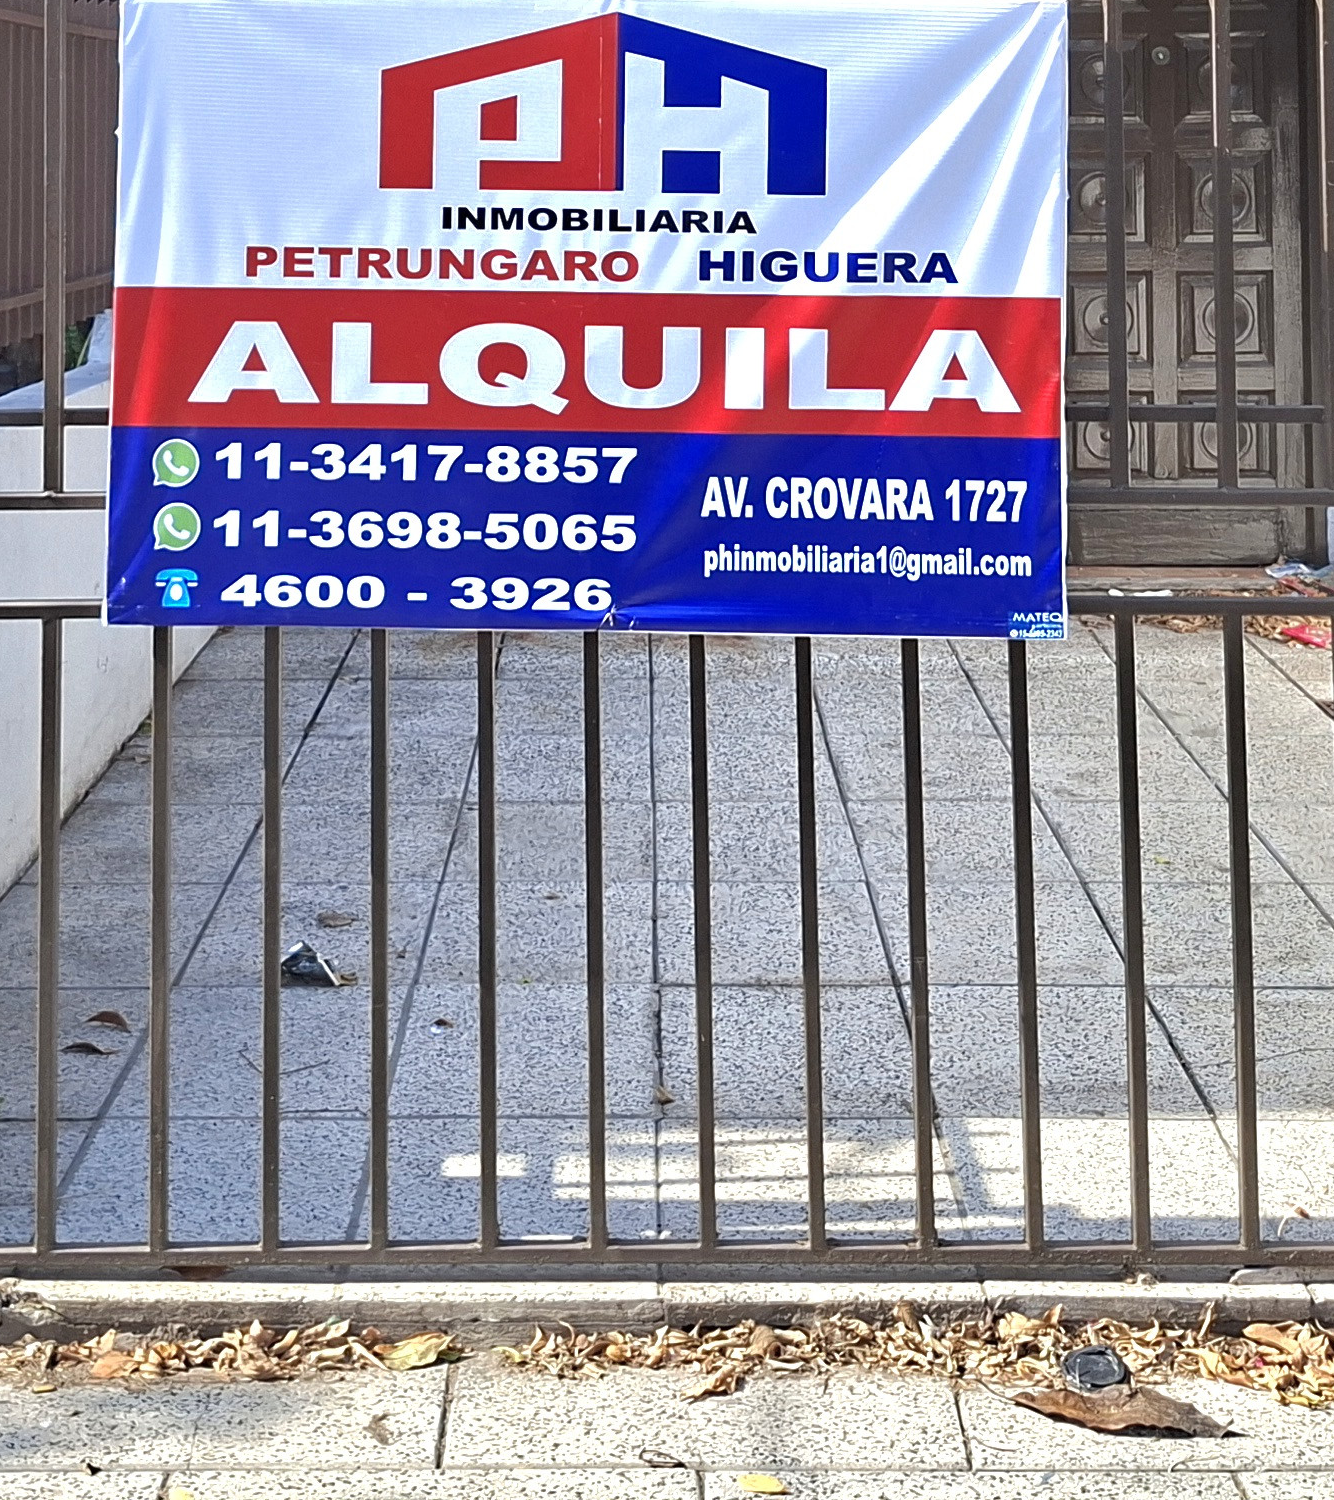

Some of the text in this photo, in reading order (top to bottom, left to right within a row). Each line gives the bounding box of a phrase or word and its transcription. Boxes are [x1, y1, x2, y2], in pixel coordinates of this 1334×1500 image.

[442, 206, 757, 234] INMOBILIARIA
[246, 246, 959, 284] PETRUNGARO HIGUERA
[187, 320, 1022, 416] ALQUILA
[215, 442, 638, 484] 11-3417-8857
[700, 476, 1028, 523] AV. CROVARA 1727
[213, 509, 637, 552] 11-3698-5065
[703, 543, 1032, 582] phinmobiliaria1@gmail.com
[220, 574, 612, 612] 4600 - 3926
[1012, 612, 1062, 623] MATEO
